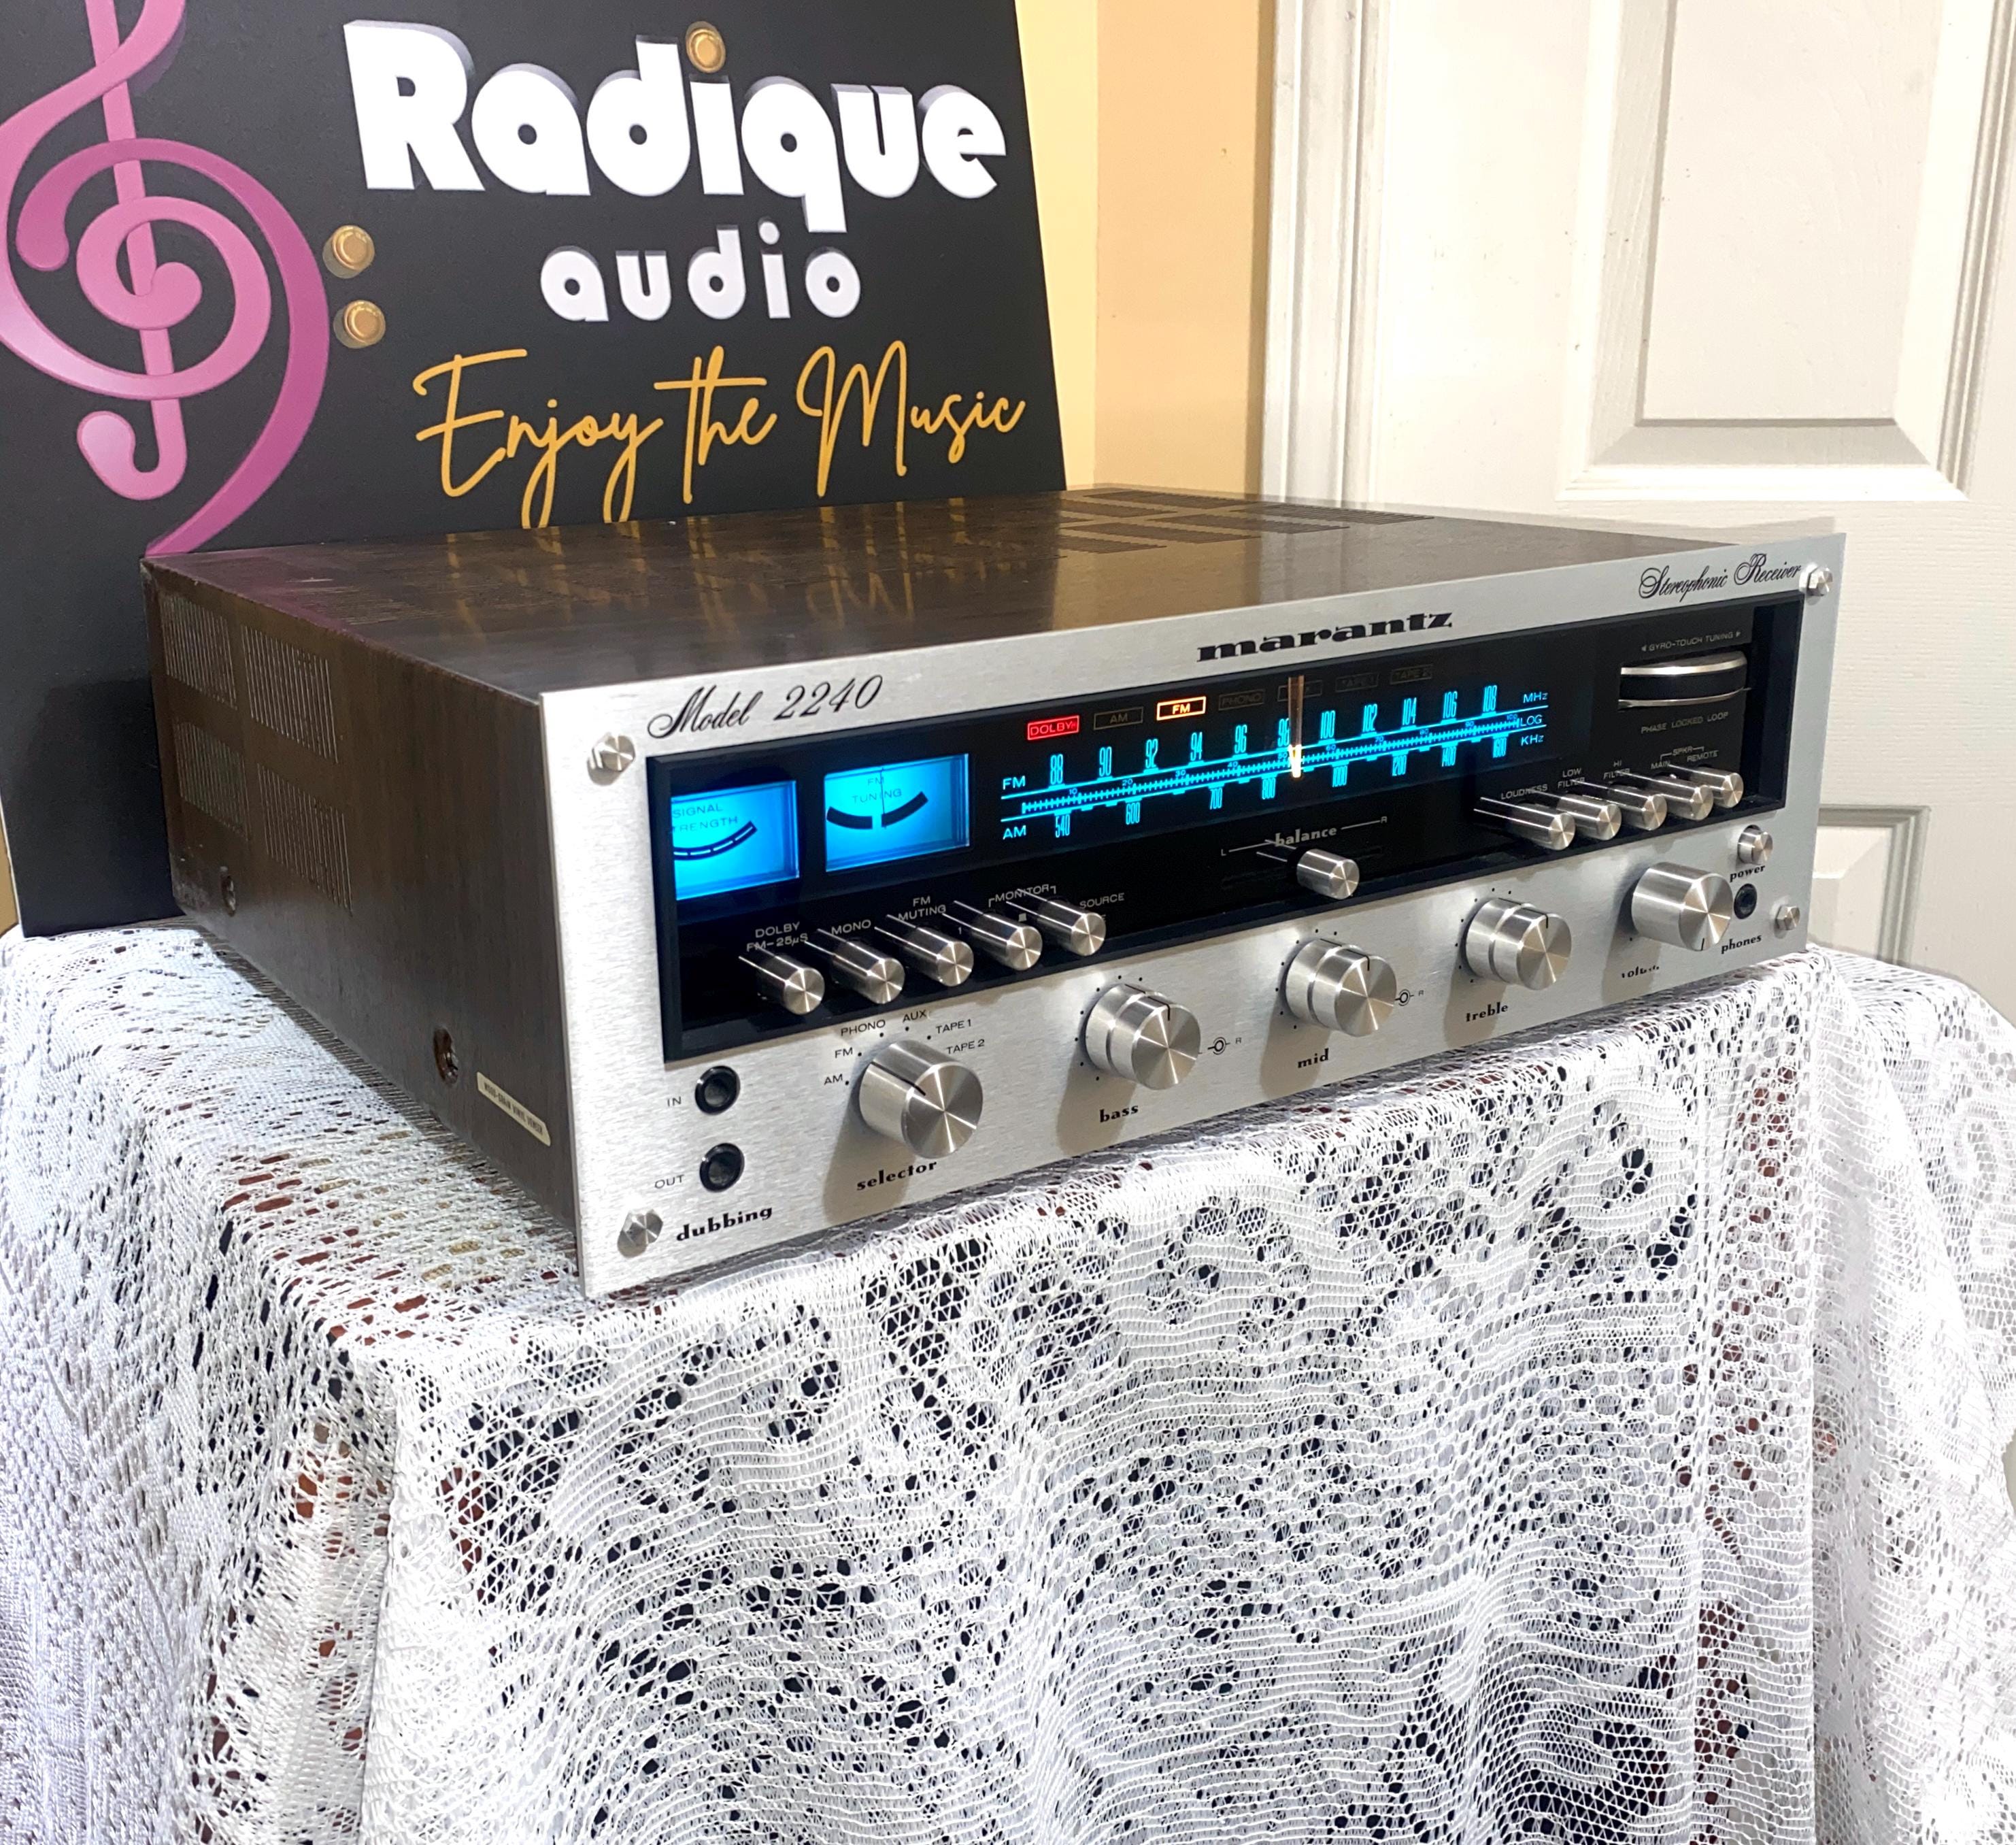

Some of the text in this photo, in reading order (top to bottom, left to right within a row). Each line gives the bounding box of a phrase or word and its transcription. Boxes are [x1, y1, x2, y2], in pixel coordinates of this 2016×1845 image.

[344, 20, 1006, 232] Radique
[541, 217, 861, 322] audio
[414, 340, 1026, 528] Enjoy the Music
[1639, 553, 1802, 602] Stereophonic Receiver
[1196, 612, 1453, 663] marantz
[1649, 632, 1734, 652] GYRO-TOUCH TUNING
[647, 675, 884, 739] Model 2240
[1221, 692, 1261, 705] PHONO
[1172, 703, 1190, 714] FM
[1109, 714, 1128, 723] AM
[1641, 712, 1728, 734] PHASE LOCKED LOOP
[1003, 776, 1026, 790] FM
[1050, 754, 1063, 784] 88
[1099, 746, 1112, 776] 90
[1145, 739, 1158, 768] 92
[1190, 731, 1203, 761] 94
[1234, 725, 1247, 754] 96
[1320, 710, 1335, 739] 100
[1362, 703, 1377, 732] 102
[1402, 697, 1417, 725] 104
[1443, 691, 1458, 719] 106
[1483, 684, 1497, 712] 108
[1523, 692, 1548, 703] MHz
[1030, 721, 1073, 736] DOLBY
[1122, 778, 1133, 786] 20
[1520, 714, 1543, 727] LOG
[1613, 760, 1622, 768] HI
[1651, 750, 1719, 770] MAIN REMOTE
[1562, 767, 1582, 778] LOW
[1603, 767, 1630, 780] FILTER
[1003, 825, 1026, 840] AM
[1056, 814, 1071, 838] 540
[1126, 802, 1140, 825] 600
[1210, 788, 1223, 810] 700
[1262, 778, 1276, 799] 800
[1332, 765, 1347, 788] 1000
[1392, 755, 1407, 776] 1200
[1441, 746, 1457, 767] 1400
[1520, 734, 1545, 746] KHz
[1557, 776, 1586, 788] FILTER
[1500, 783, 1548, 800] LOUDNESS
[672, 803, 724, 818] SIGNAL
[672, 816, 739, 833] TRENGTH
[1275, 827, 1337, 847] balance
[1730, 865, 1766, 882] power
[913, 896, 931, 907] FM
[995, 884, 1125, 910] MONITOR SOURCE
[898, 904, 947, 921] MUTING
[755, 921, 800, 938] DOLBY
[831, 919, 871, 935] MONO
[1721, 935, 1762, 954] phones
[902, 1010, 927, 1023] AUX
[1465, 1002, 1509, 1023] treble
[841, 1019, 886, 1036] PHONO
[936, 1021, 966, 1034] TAPE
[835, 1047, 853, 1059] FM
[947, 1039, 985, 1054] TAPE 2
[1297, 1048, 1330, 1068] mid
[824, 1074, 843, 1085] AM
[667, 1096, 682, 1108] IN
[1099, 1104, 1139, 1123] bass
[654, 1174, 684, 1189] OUT
[856, 1160, 937, 1191] selector
[676, 1207, 773, 1242] dubbing
